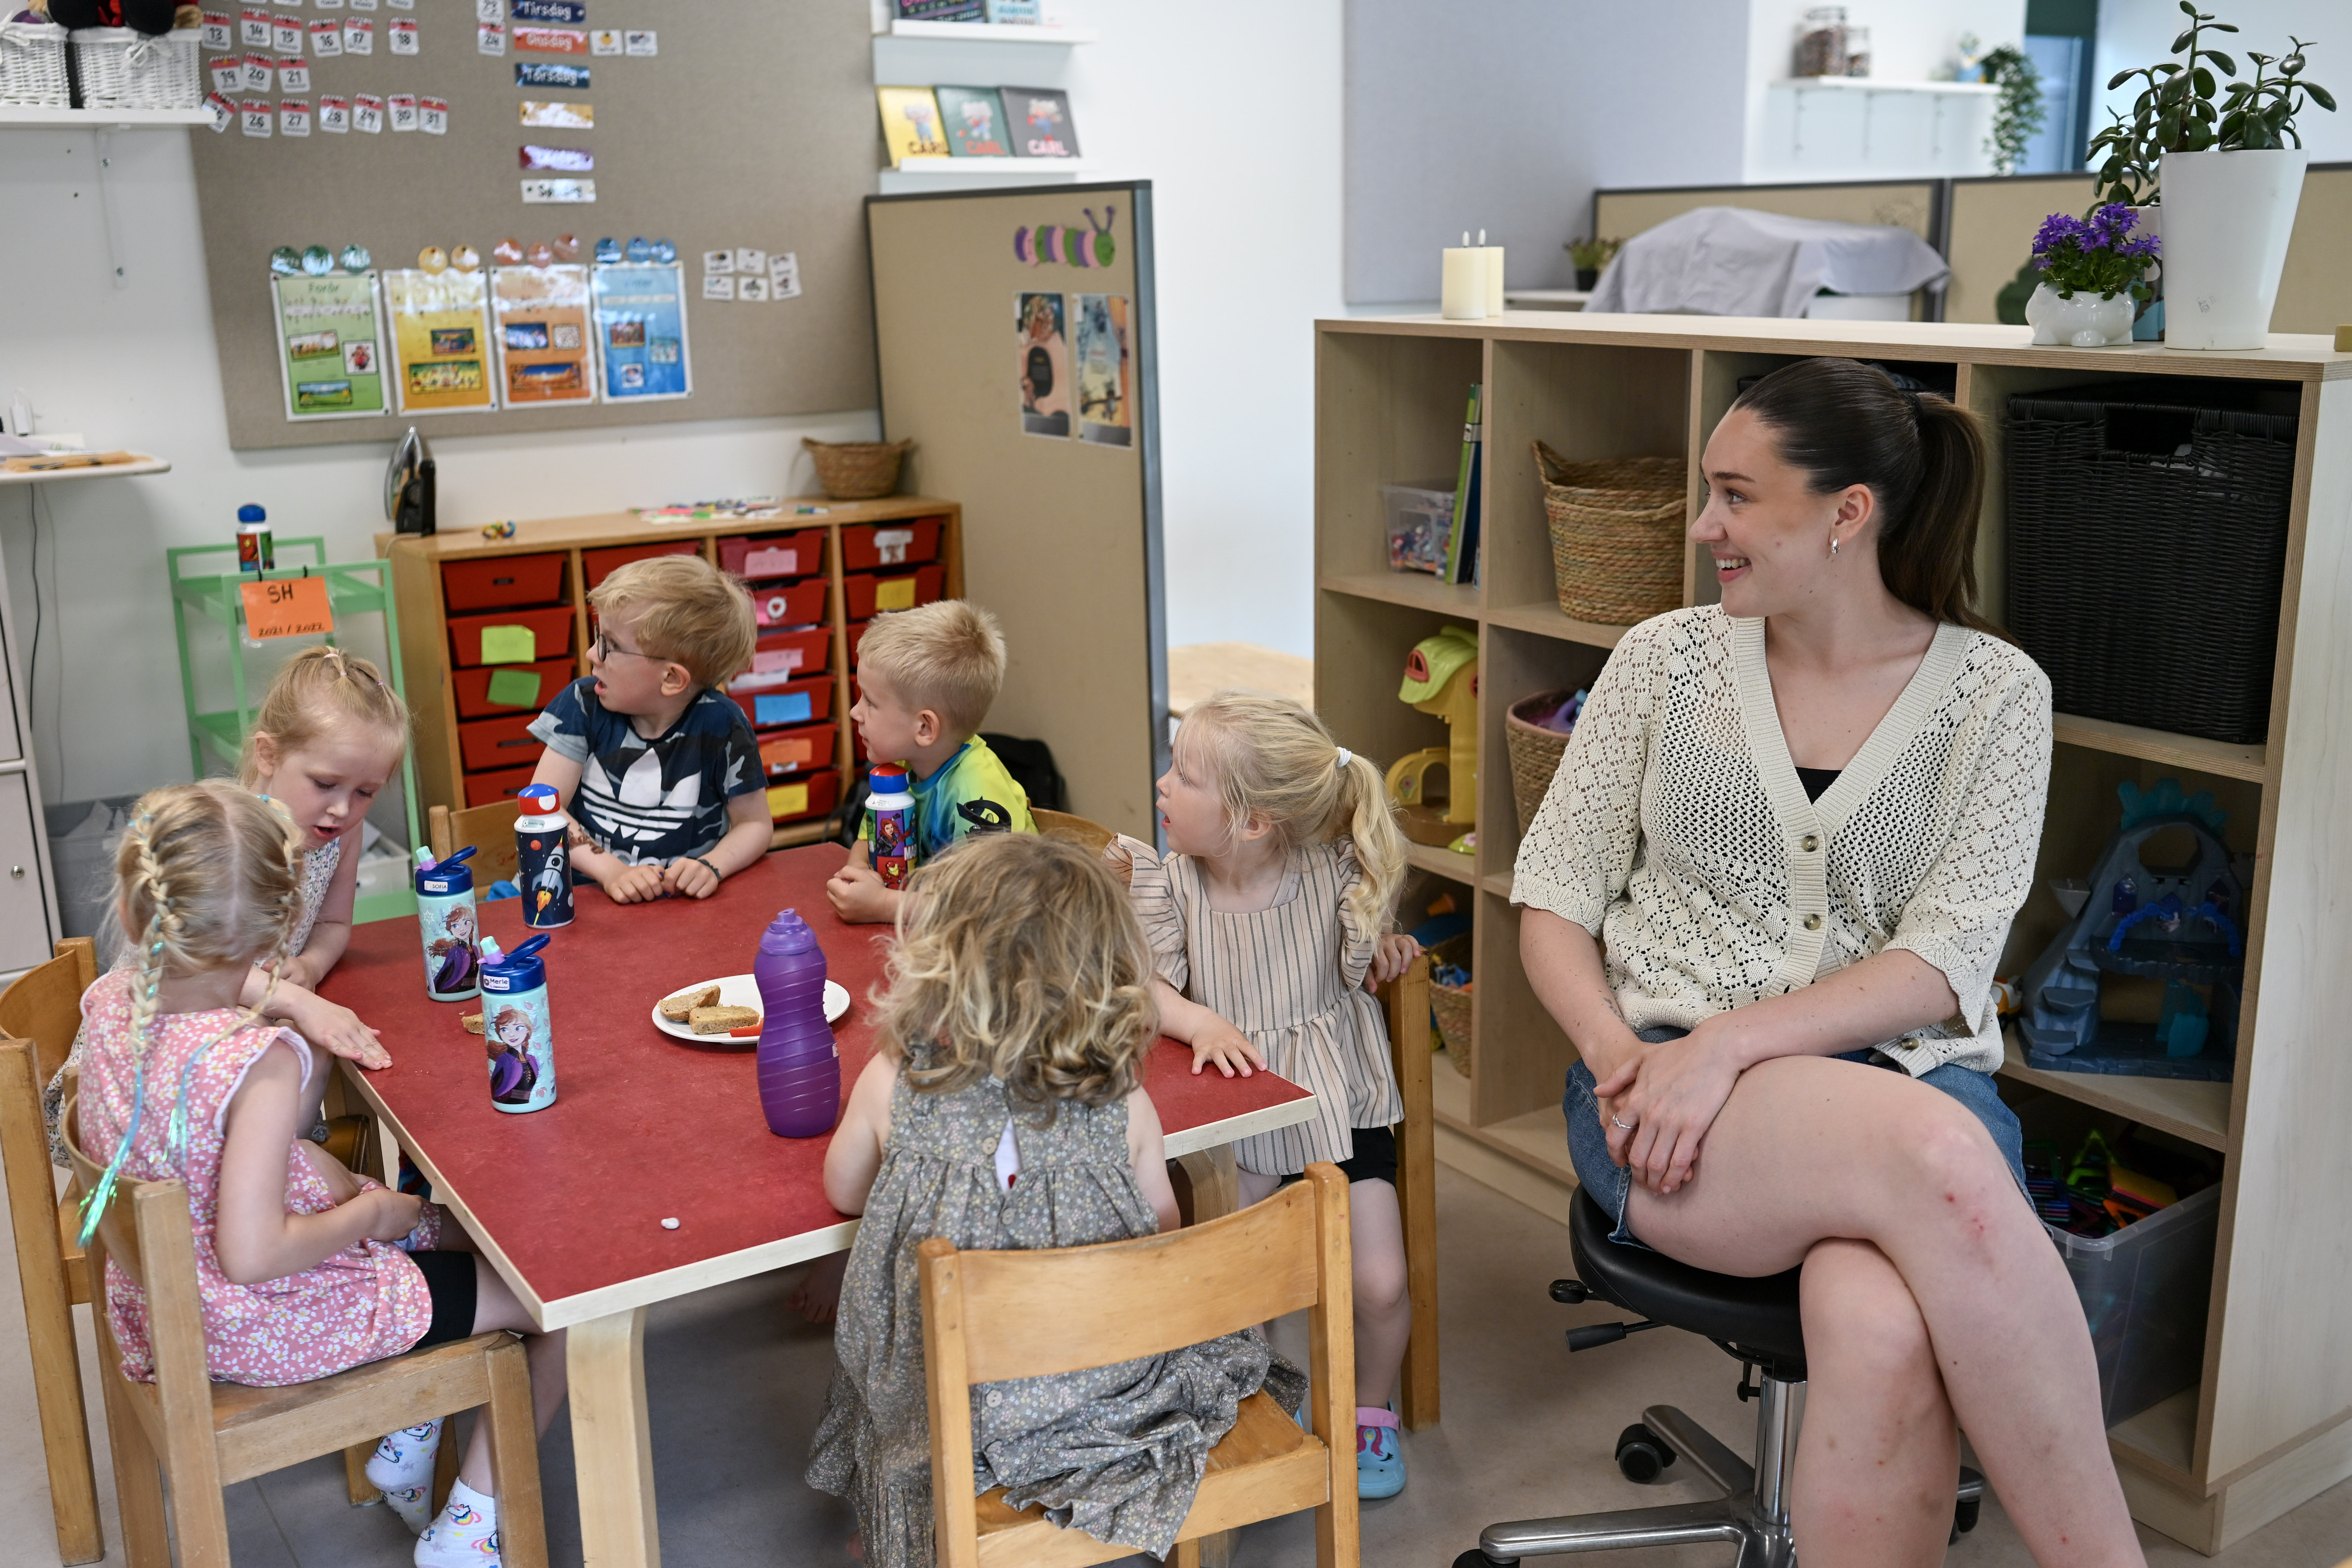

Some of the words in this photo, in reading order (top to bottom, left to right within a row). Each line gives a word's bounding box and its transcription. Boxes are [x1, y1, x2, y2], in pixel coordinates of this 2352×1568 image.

[524, 2, 571, 21] Tirsdag
[249, 23, 263, 36] 14
[281, 30, 294, 43] 15
[319, 34, 334, 48] 16
[352, 32, 364, 44] 17
[526, 32, 572, 51] Onsdag
[220, 70, 236, 85] 19
[248, 66, 265, 81] 20
[286, 70, 301, 83] 21
[526, 68, 577, 86] Torsdag
[248, 113, 264, 128] 26
[287, 114, 303, 126] 27
[326, 110, 342, 123] 28
[359, 108, 376, 125] 29
[908, 141, 951, 155] CARL
[966, 140, 1006, 155] CARL
[1027, 140, 1069, 156] CARL
[268, 583, 293, 604] SH
